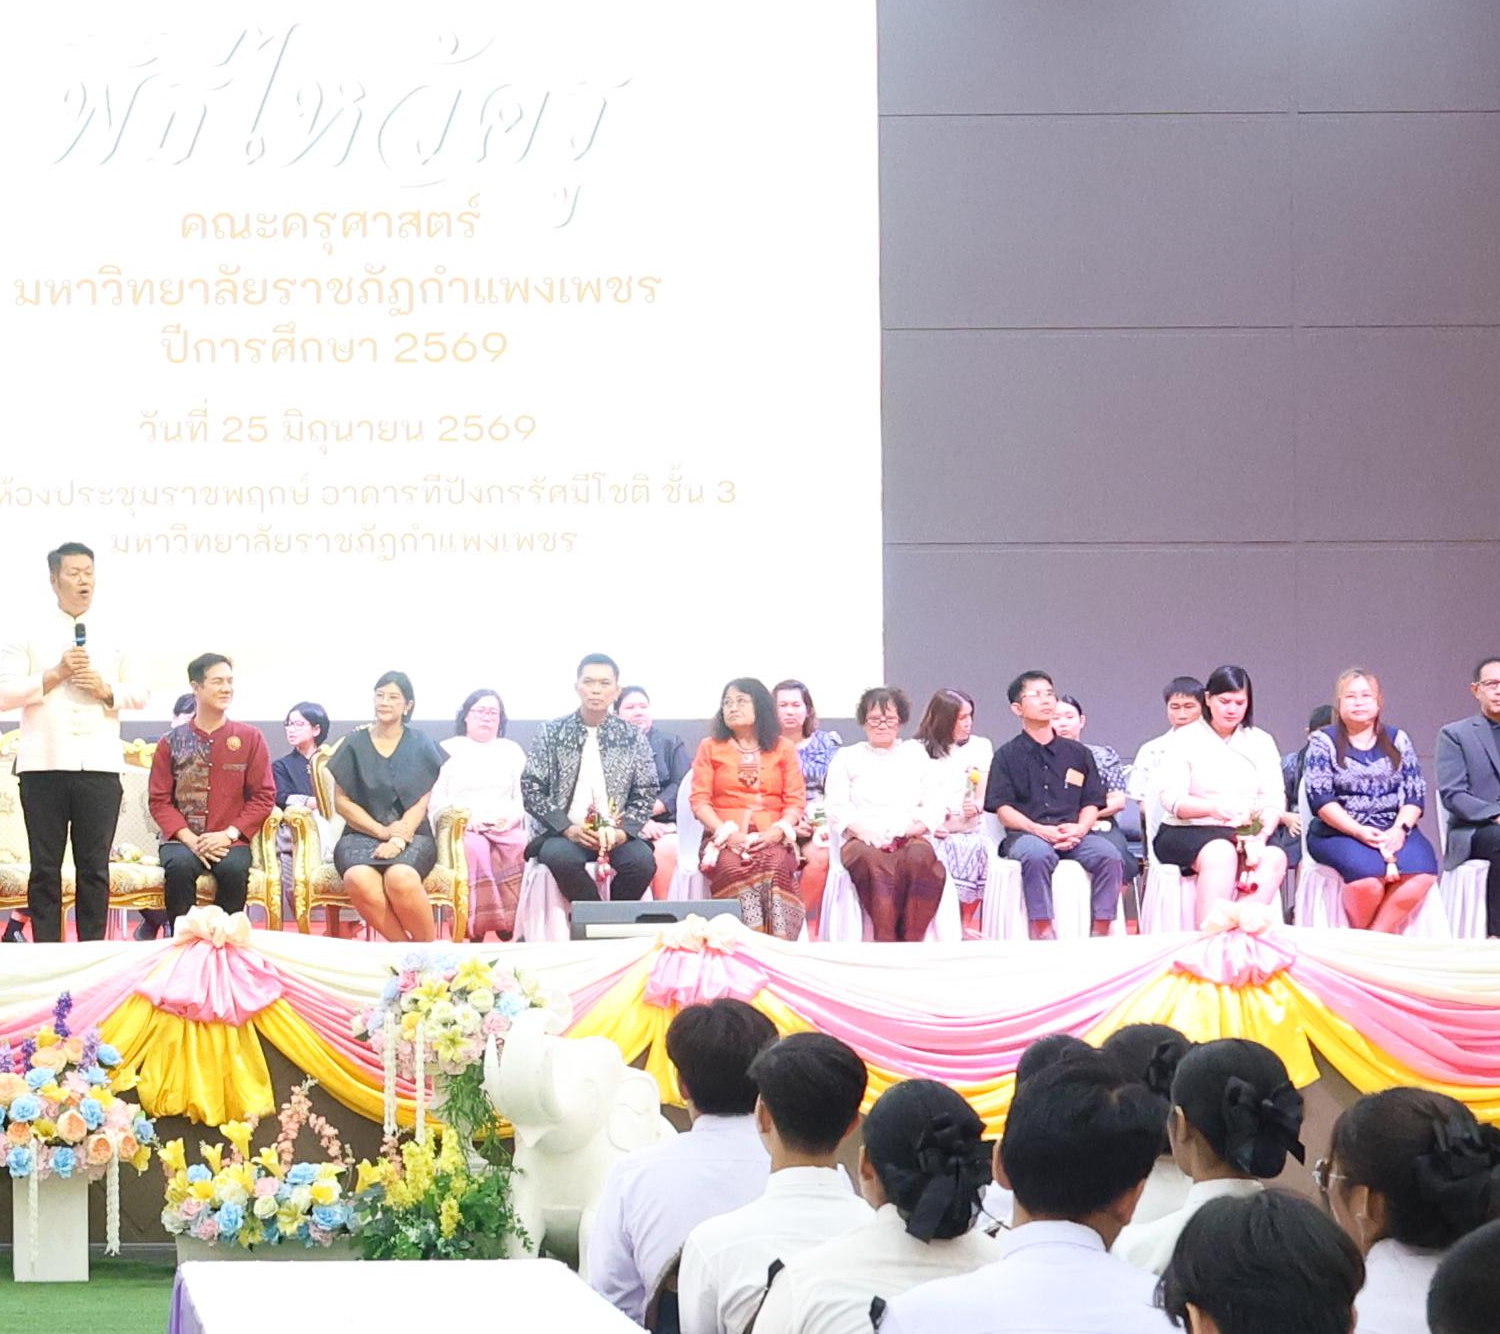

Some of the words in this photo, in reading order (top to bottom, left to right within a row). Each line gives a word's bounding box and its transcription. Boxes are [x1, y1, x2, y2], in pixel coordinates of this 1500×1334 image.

[181, 194, 480, 255] คณะครุศาสตร์
[13, 264, 663, 317] มหาวิทยาลัยราชภัฏกำแพงเพชร
[161, 322, 378, 365] ปีการศึกษา
[394, 330, 509, 365] 2569
[137, 400, 208, 444] วันที่
[222, 413, 269, 444] 25
[282, 407, 424, 455] มิถุนายน
[437, 413, 538, 444] 2569
[662, 464, 705, 508] ชั้น
[716, 482, 736, 508] 3
